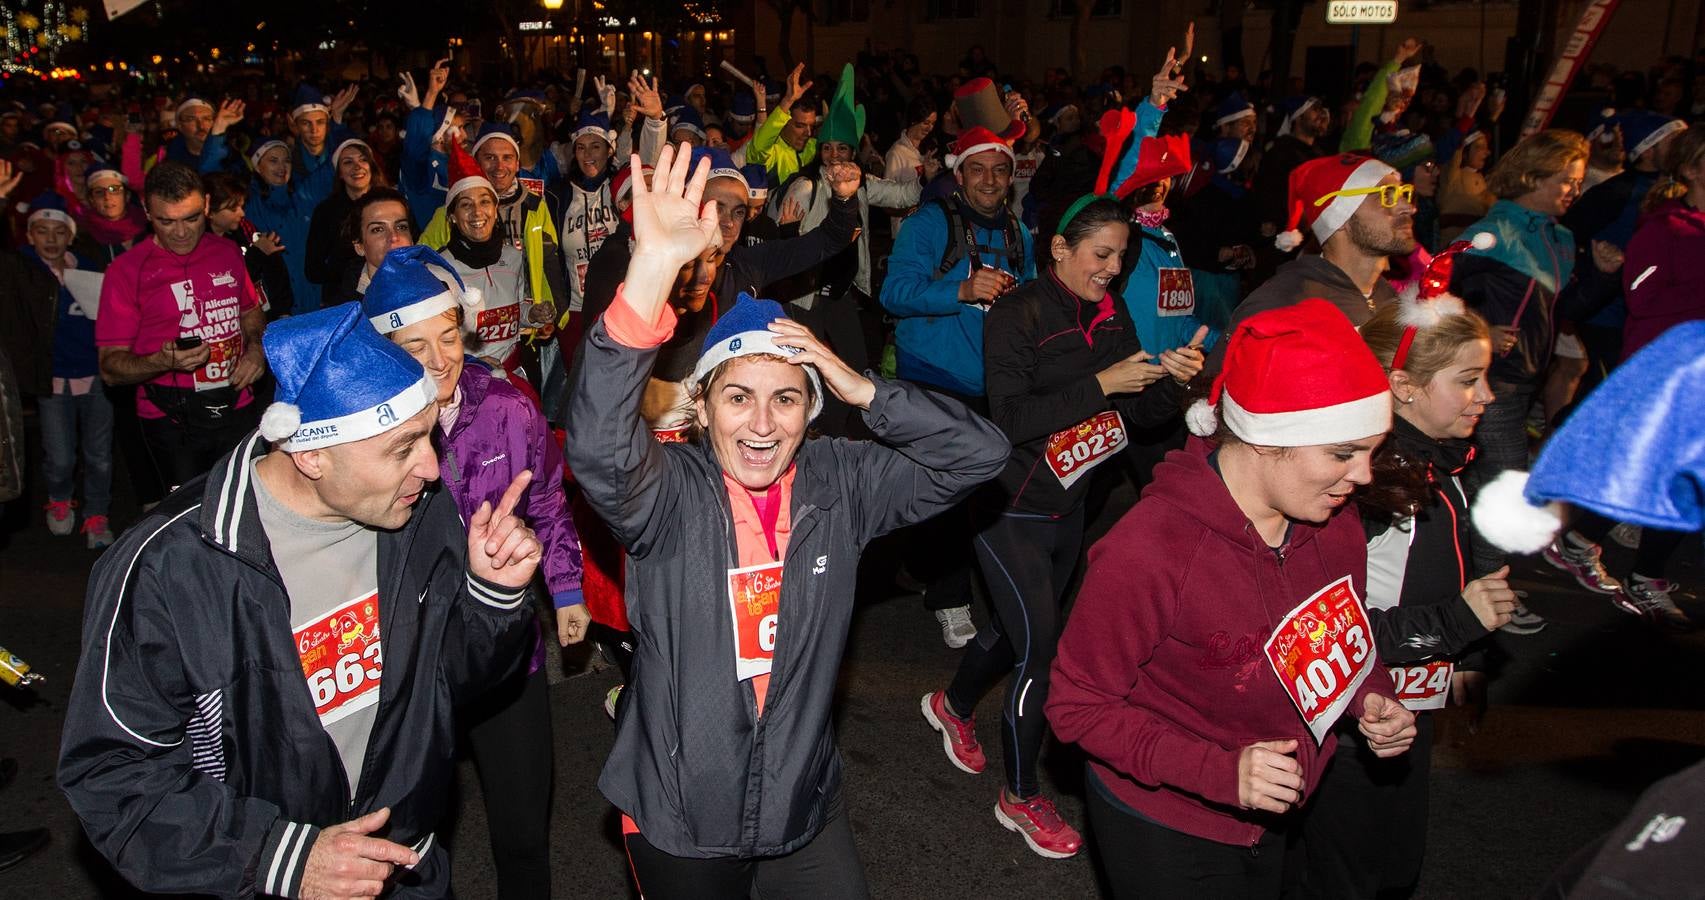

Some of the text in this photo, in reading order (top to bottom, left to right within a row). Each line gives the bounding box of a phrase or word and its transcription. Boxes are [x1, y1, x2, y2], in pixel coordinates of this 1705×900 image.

[1333, 4, 1392, 17] SÓLO MOTOS
[205, 296, 238, 309] Alicante
[1162, 290, 1191, 307] 1890
[479, 321, 518, 340] 2279
[1056, 427, 1125, 472] 3023
[1295, 625, 1369, 713] 4013
